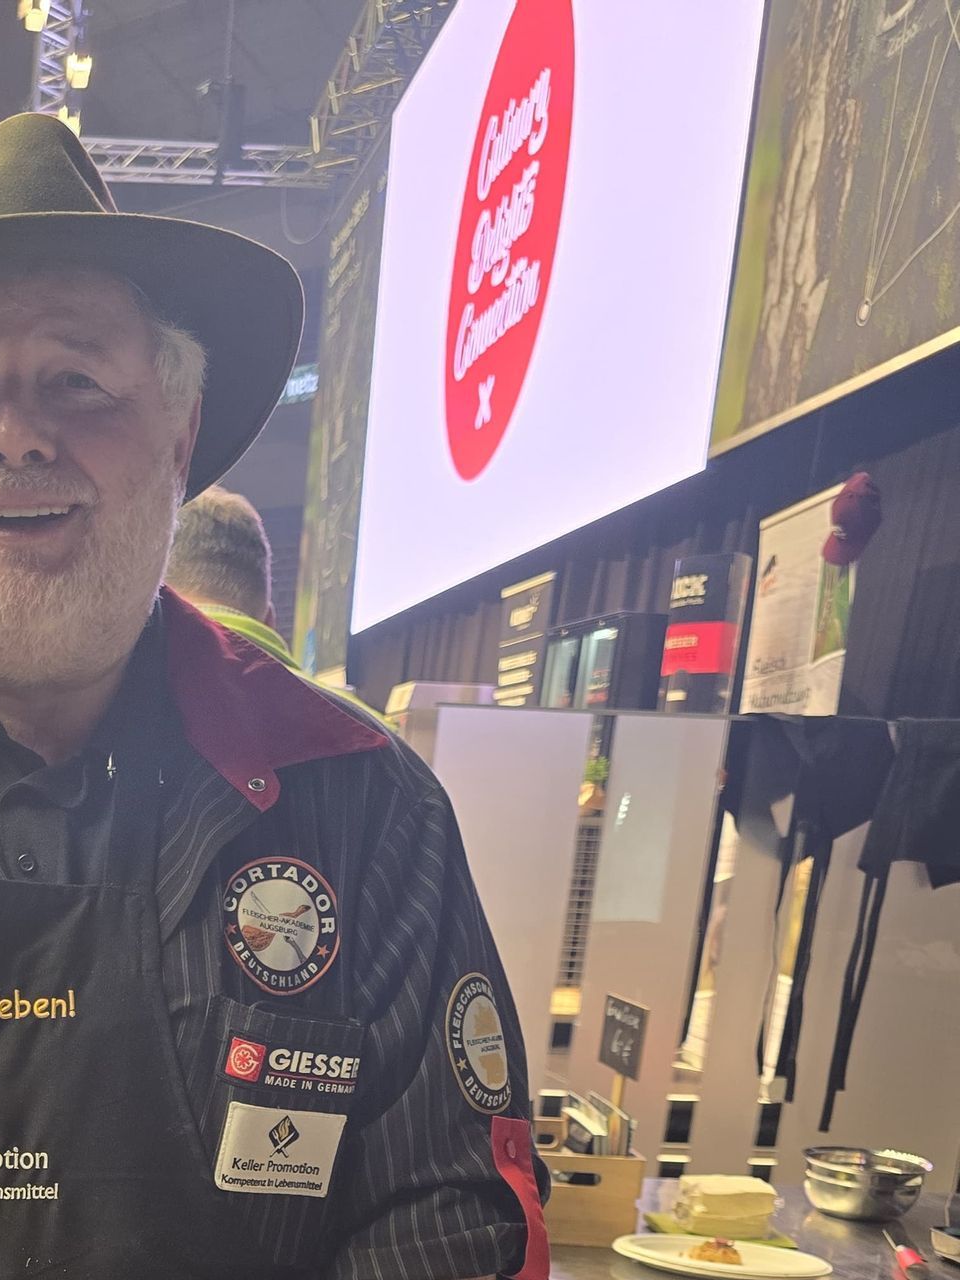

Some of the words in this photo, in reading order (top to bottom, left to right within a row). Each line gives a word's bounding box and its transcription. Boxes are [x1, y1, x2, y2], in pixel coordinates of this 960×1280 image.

[477, 68, 551, 201] Culinary
[453, 257, 541, 381] Convention
[224, 864, 336, 934] CORTADOR
[242, 908, 315, 932] FLEISCHER-AKADEMIE
[259, 922, 298, 936] AUGSBURG
[234, 941, 319, 988] DEUTSCHLAND
[264, 1075, 297, 1089] MADE
[301, 1080, 313, 1091] IN
[231, 1157, 265, 1172] Keller
[266, 1160, 320, 1175] Promotion
[221, 1173, 266, 1188] Kompetenz
[275, 1178, 323, 1191] Lebensmittel
